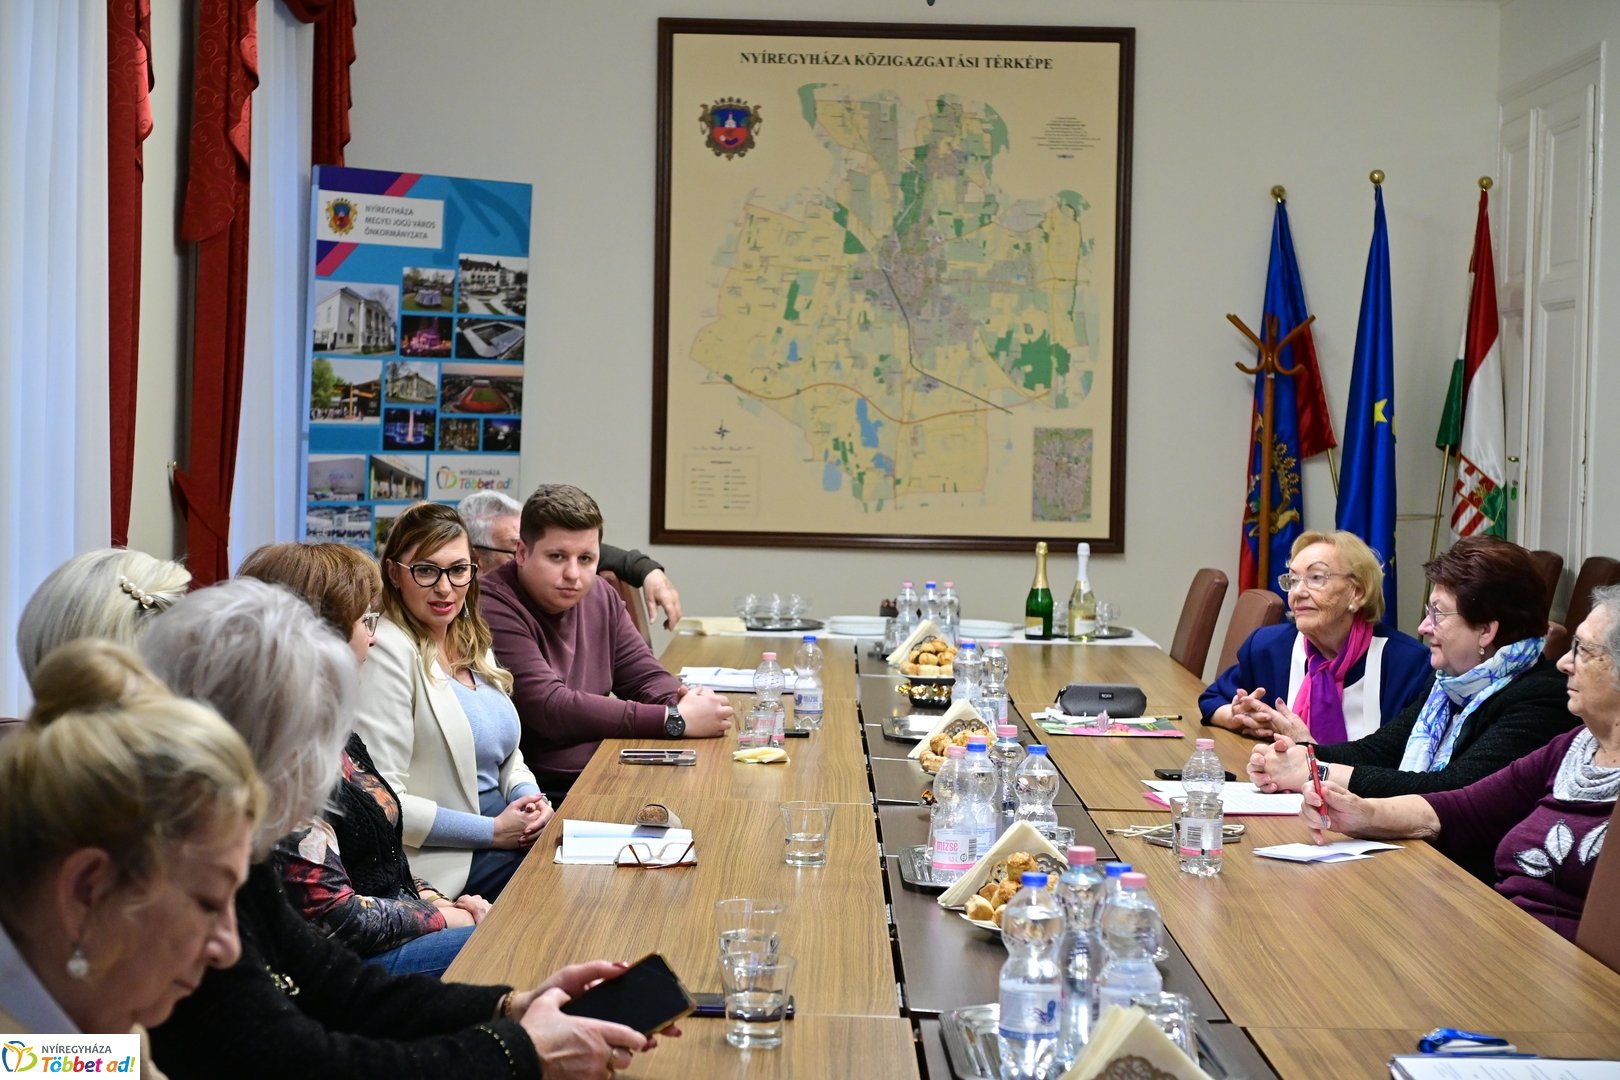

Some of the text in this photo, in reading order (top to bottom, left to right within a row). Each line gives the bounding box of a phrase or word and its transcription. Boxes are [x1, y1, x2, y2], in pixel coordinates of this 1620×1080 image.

[740, 50, 1054, 70] NYÍREGYHÁZA KÖZIGAZGATÁSI TÉRKÉPE
[365, 204, 414, 215] NYÍREGYHÁZA
[365, 216, 391, 226] MEGYEI
[413, 219, 436, 229] VÁROS
[364, 227, 428, 239] ÖNKORMÁNYZATA
